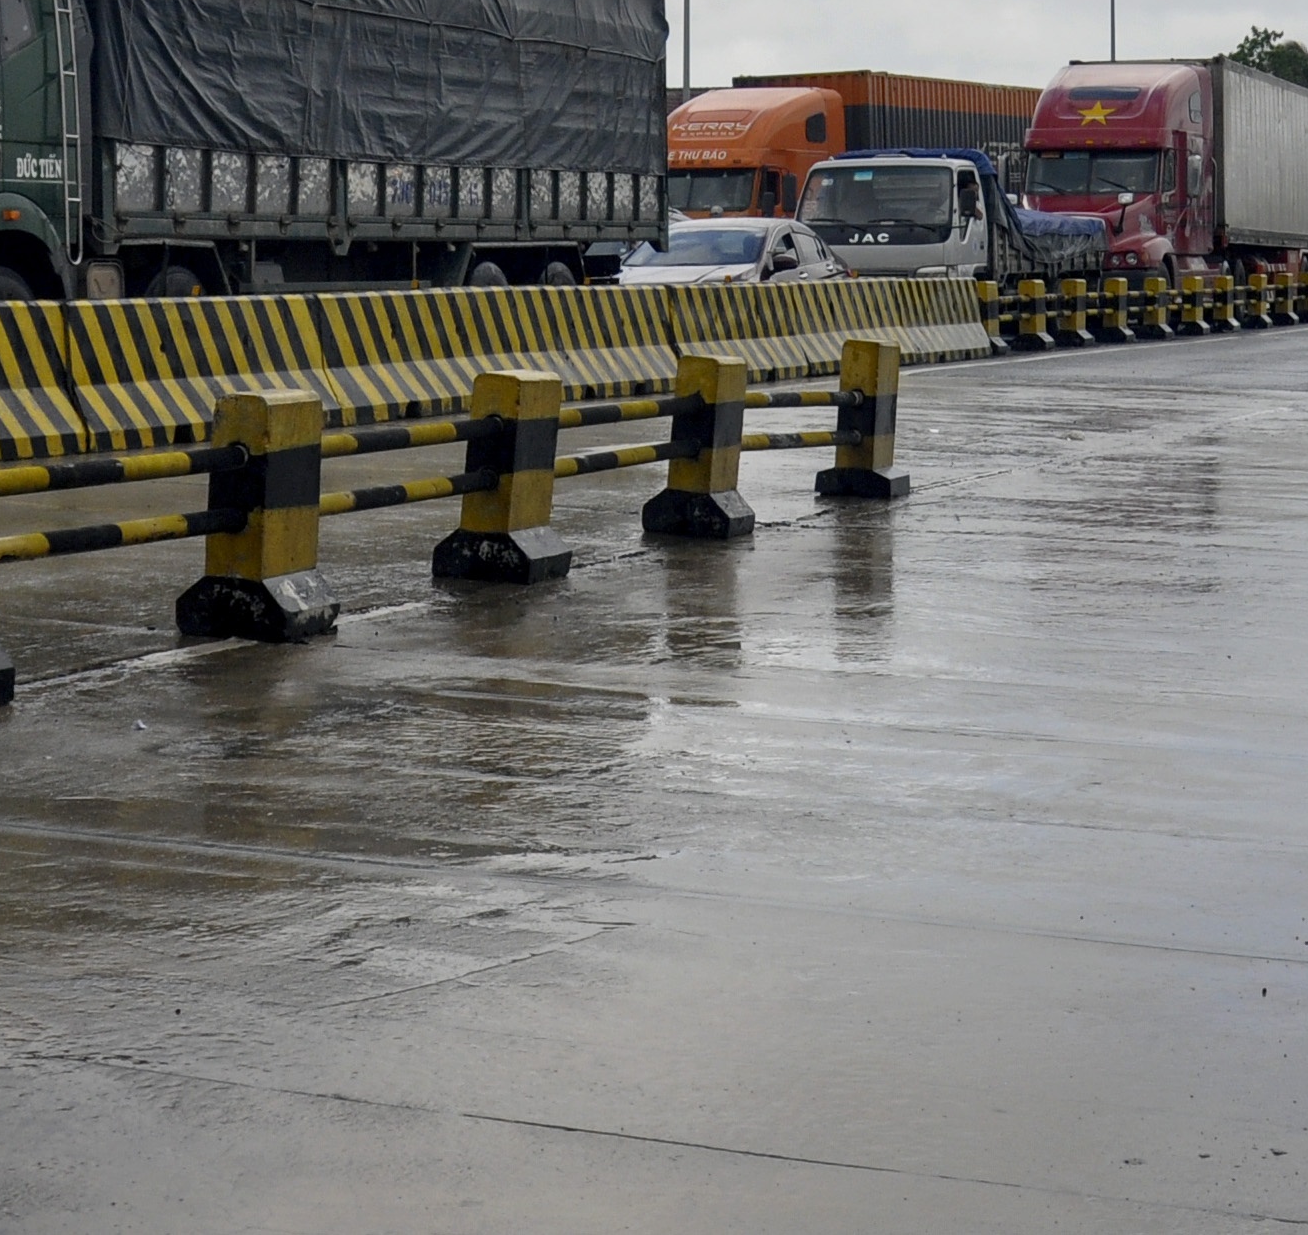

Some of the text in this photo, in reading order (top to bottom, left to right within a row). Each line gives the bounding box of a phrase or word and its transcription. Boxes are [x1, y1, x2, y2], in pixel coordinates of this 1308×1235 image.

[672, 122, 753, 131] KERRY
[678, 149, 703, 160] THƯ
[16, 152, 62, 179] ĐỨC TIẾN
[848, 232, 890, 244] JAC
